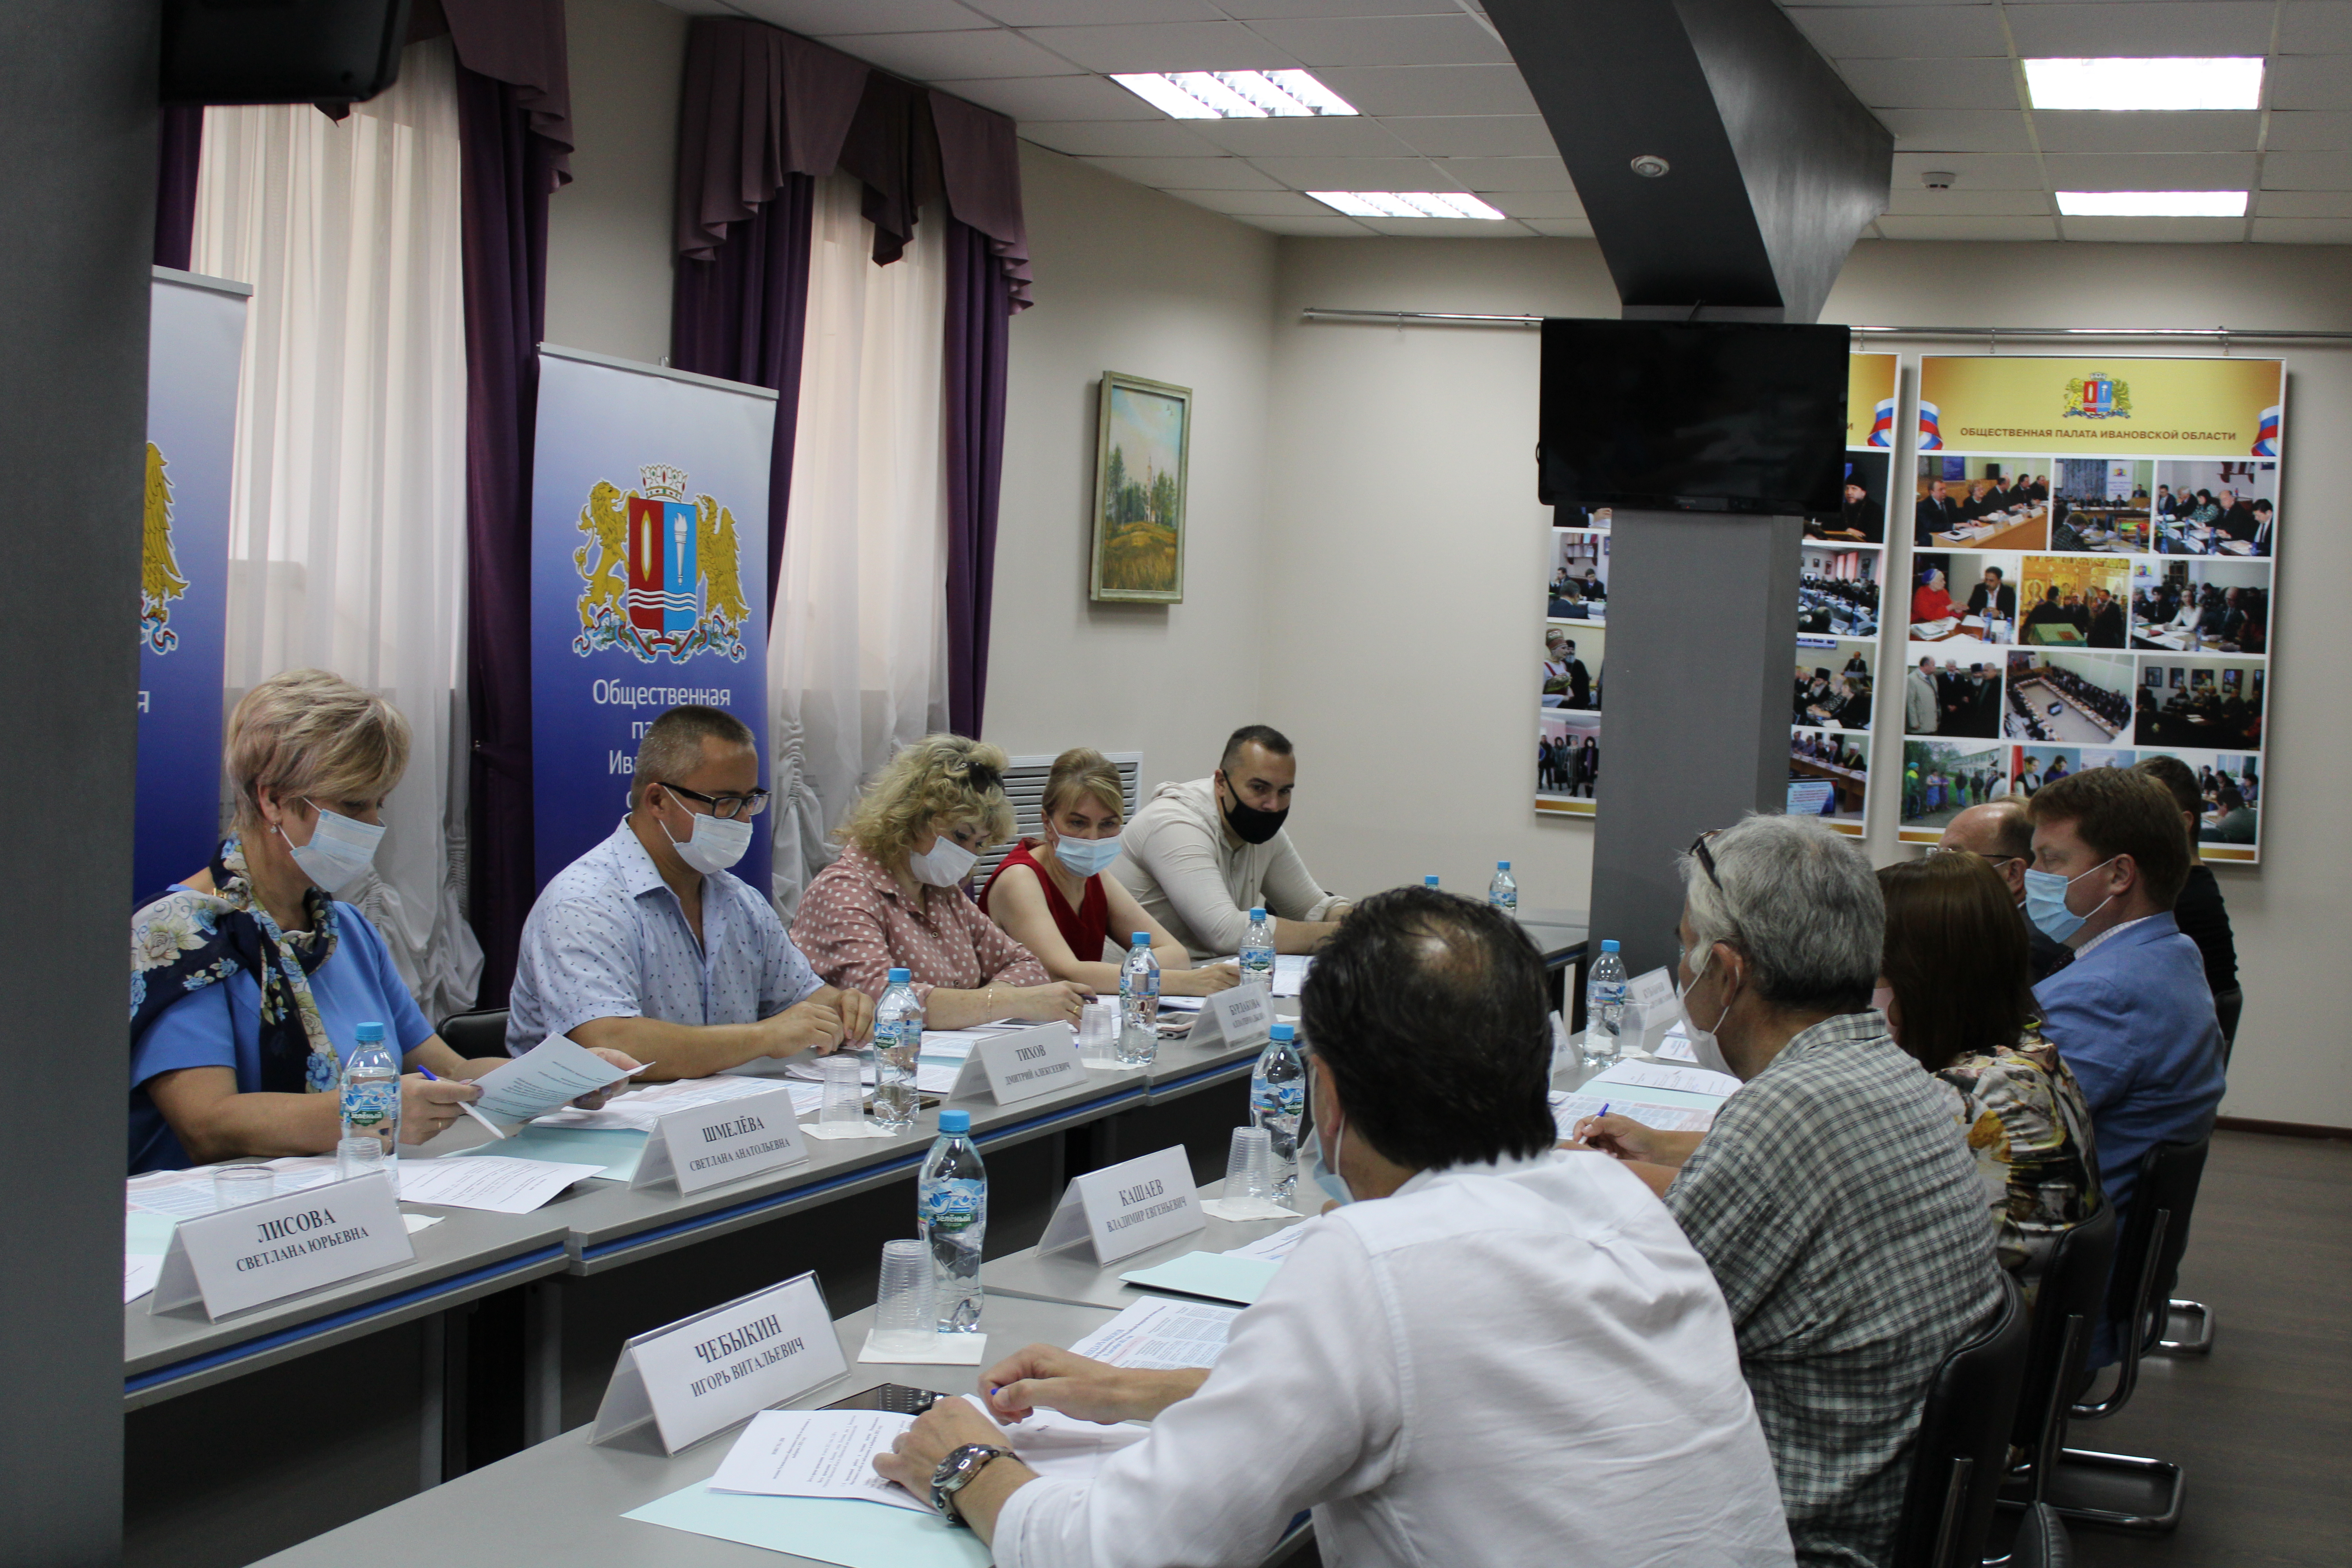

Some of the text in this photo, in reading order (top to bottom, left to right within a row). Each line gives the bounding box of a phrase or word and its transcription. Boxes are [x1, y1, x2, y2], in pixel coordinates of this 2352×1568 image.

[1960, 427, 2236, 441] ОБЩЕСТВЕННАЯ ПАЛАТА ИВАНОВСКОЙ ОБЛАСТИ
[592, 679, 731, 709] Общественная
[1015, 1045, 1047, 1062] ТИХОВ
[702, 1115, 765, 1142] ШМЕЛЁВА
[690, 1138, 791, 1171] СВЕТЛАНА АНАТОЛЬЕВНА
[1118, 1179, 1164, 1207] КАШАЕВ
[256, 1208, 336, 1243] ЛИСОВА
[1106, 1196, 1187, 1232] ВЛАДИМИР ЕВГЕНЬЕВИЧ
[236, 1226, 369, 1272] СВЕТЛАНА ЮРЬЕВНА
[694, 1314, 783, 1364] ЧЕБЫКИН
[690, 1337, 806, 1397] ИГОРЬ ВИТАЛЬЕВИЧ
